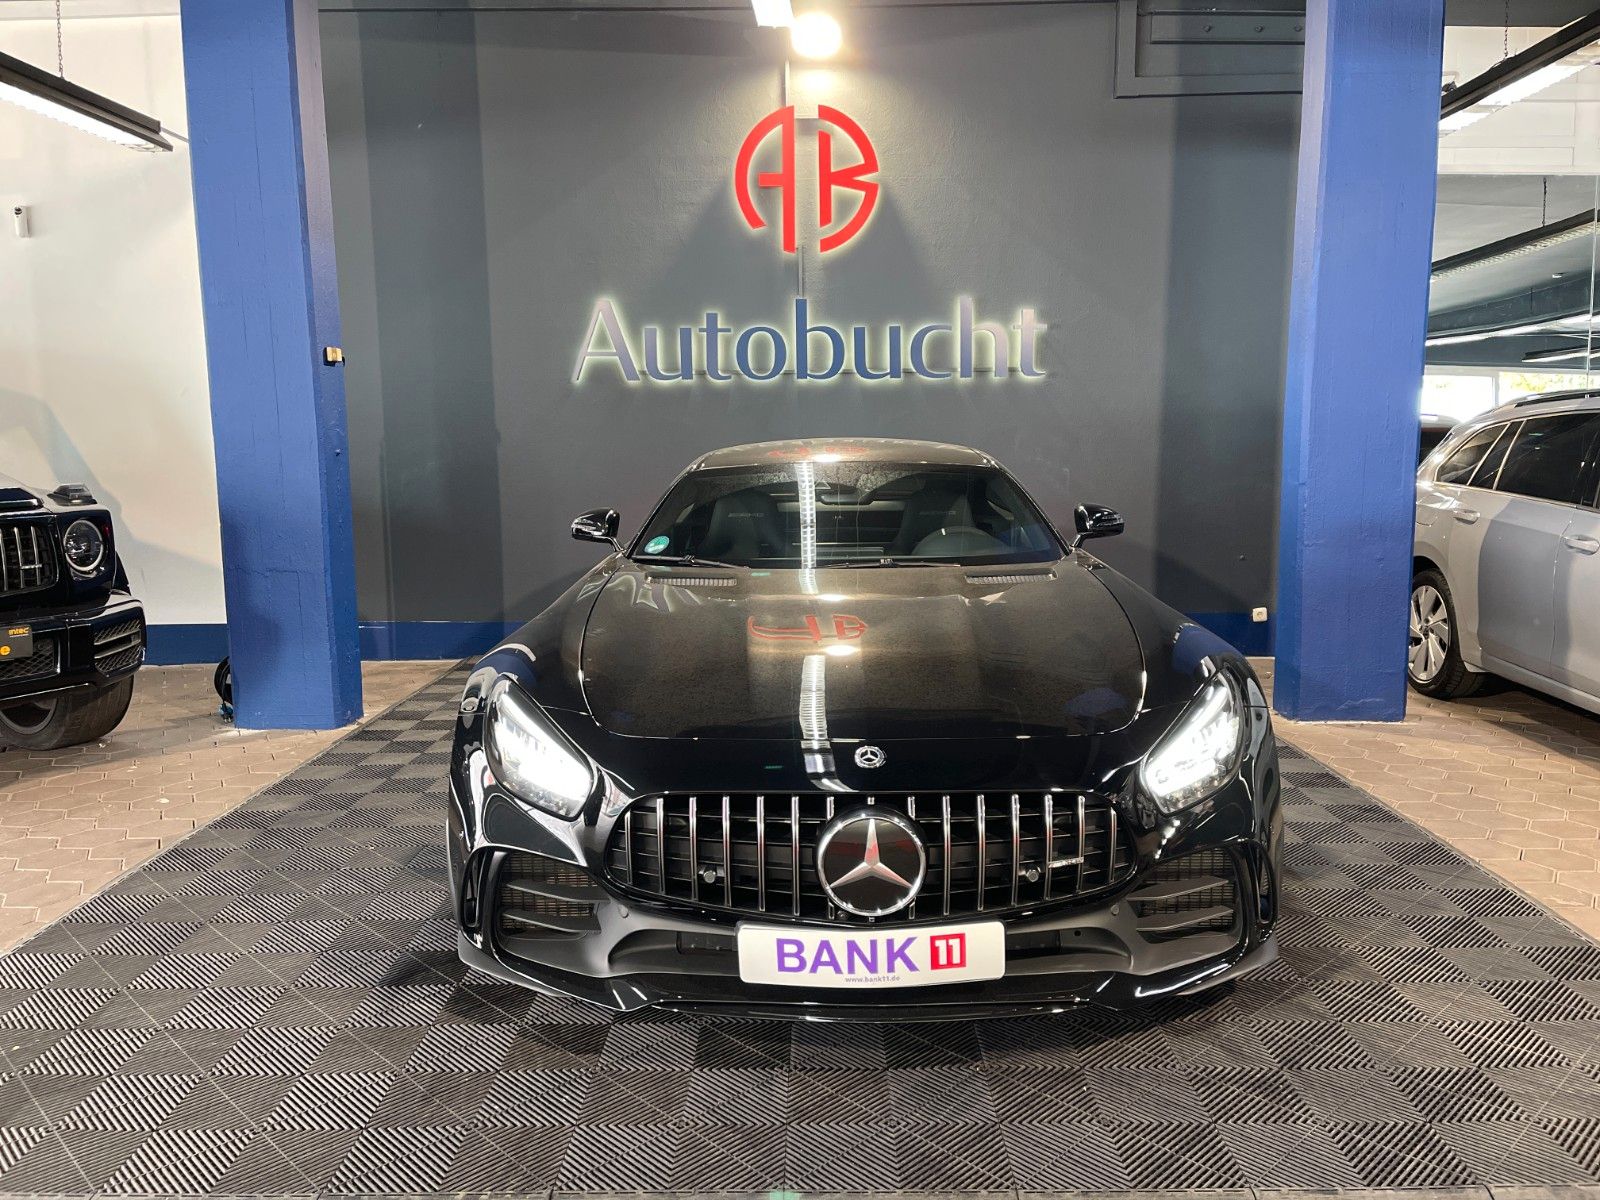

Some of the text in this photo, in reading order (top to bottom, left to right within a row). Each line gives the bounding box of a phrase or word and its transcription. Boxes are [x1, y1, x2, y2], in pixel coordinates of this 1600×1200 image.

[735, 104, 880, 254] AB
[571, 298, 1048, 381] Autobucht
[776, 937, 963, 974] BANK 11
